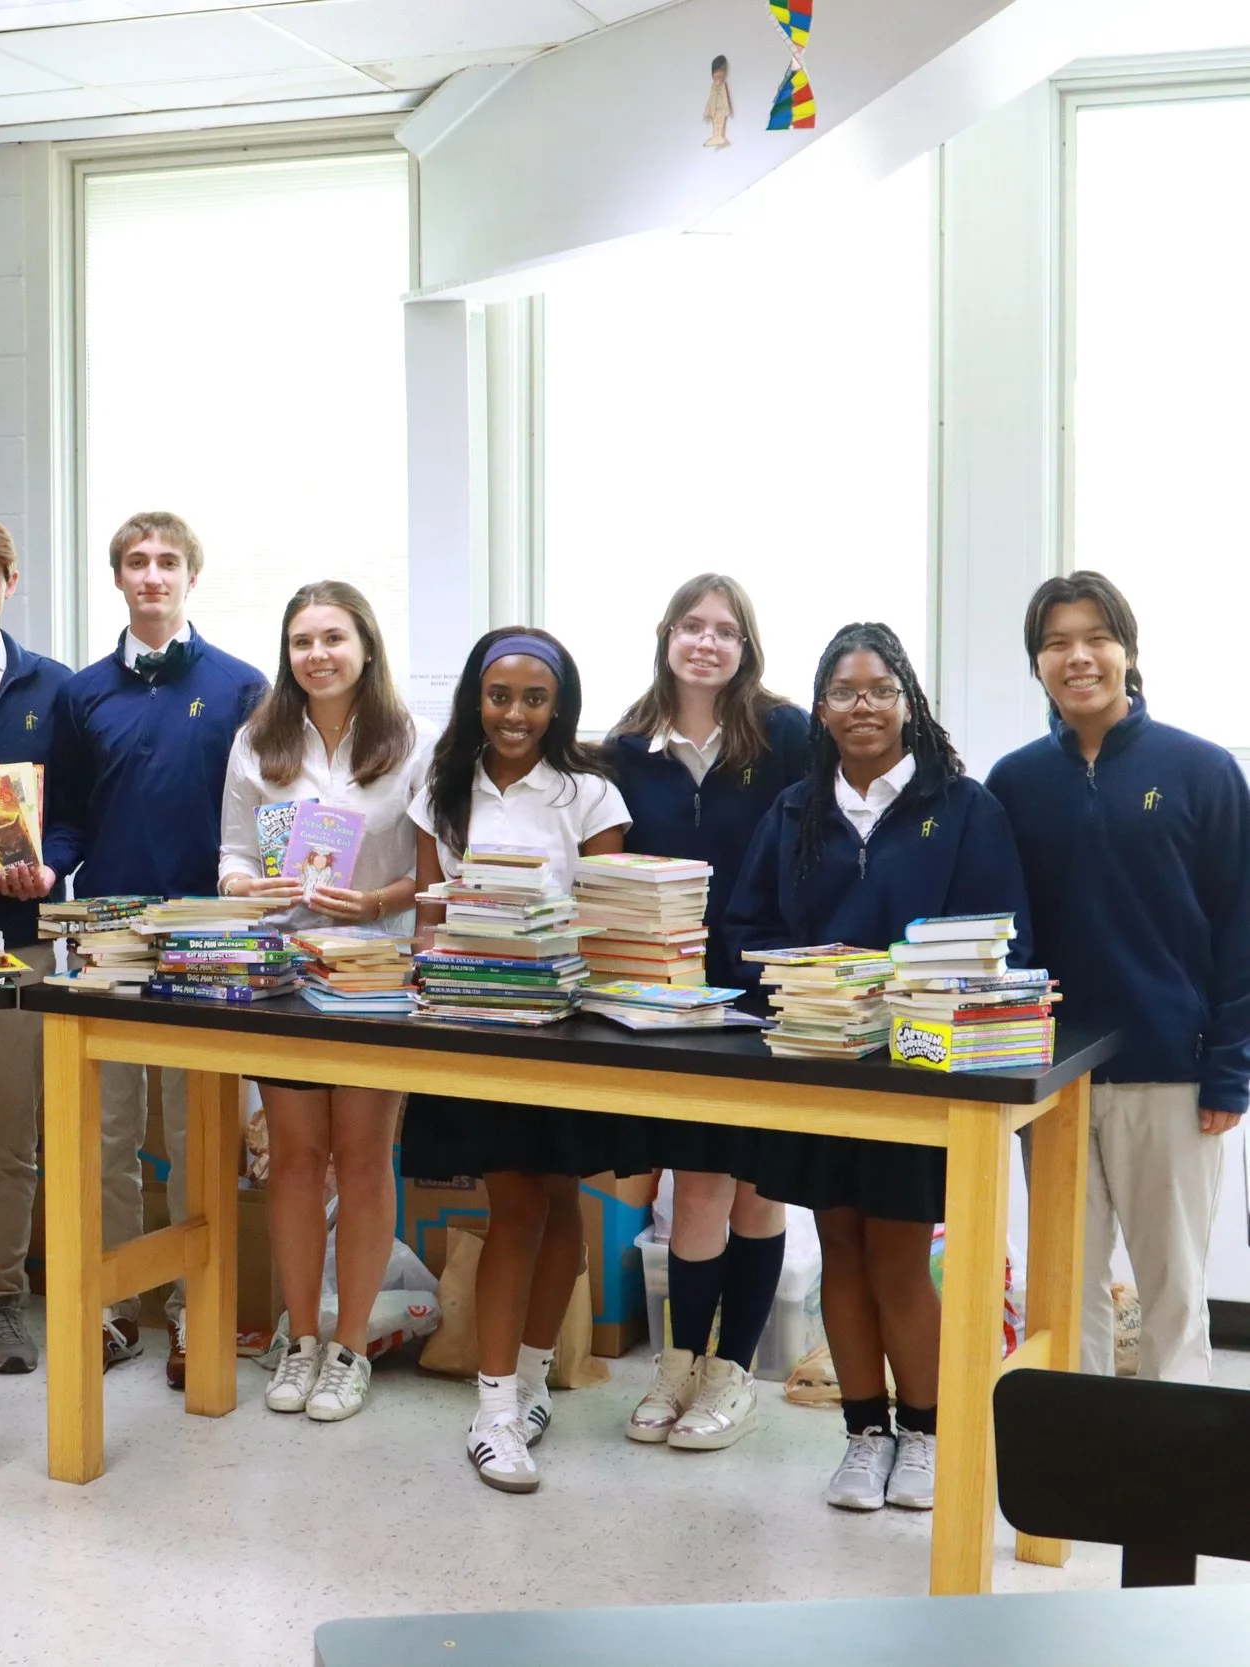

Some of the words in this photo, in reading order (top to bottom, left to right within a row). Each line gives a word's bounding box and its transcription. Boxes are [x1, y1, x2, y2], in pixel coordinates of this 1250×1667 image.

[190, 940, 203, 948] DOG
[204, 940, 217, 948] MAN
[187, 974, 200, 982] DOG
[172, 984, 183, 993] DOG
[896, 1027, 943, 1046] CAPTAIN
[903, 1048, 941, 1063] COLLECTION
